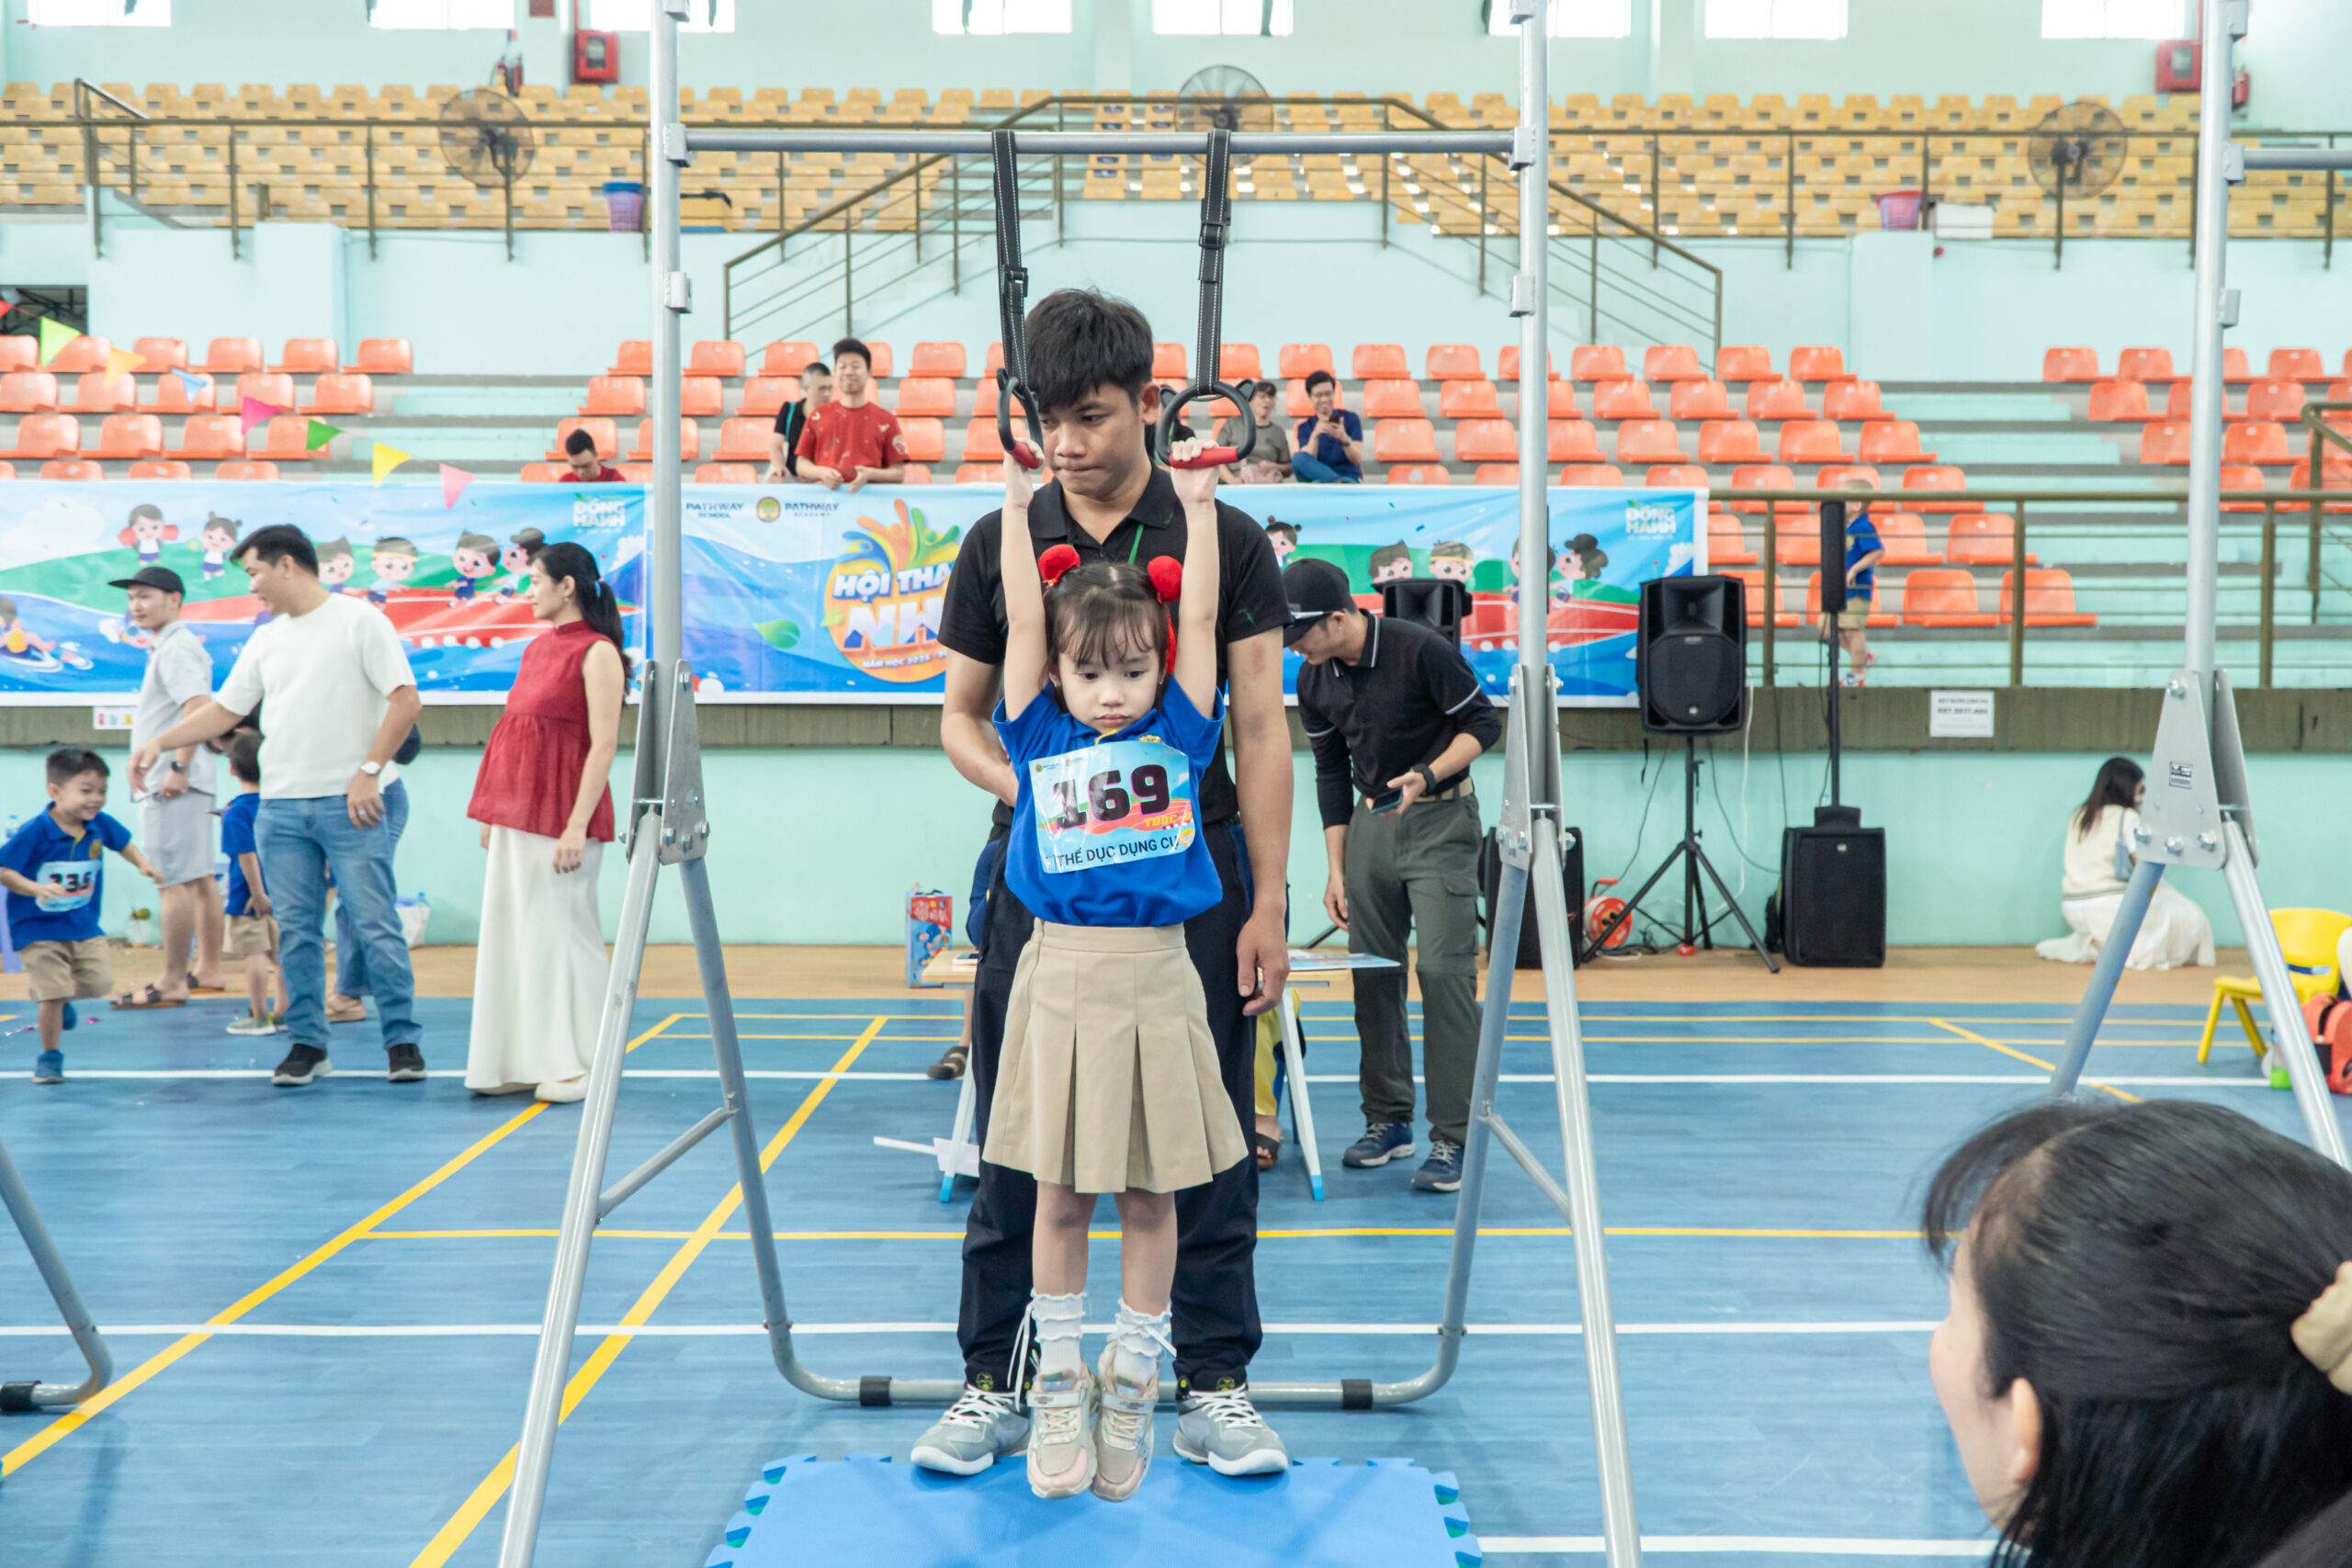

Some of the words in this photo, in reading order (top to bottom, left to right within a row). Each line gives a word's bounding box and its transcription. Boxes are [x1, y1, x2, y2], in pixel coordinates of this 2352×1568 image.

[686, 502, 744, 511] PATHWAY
[785, 502, 840, 511] PATHWAY
[831, 568, 891, 604] HỘI
[896, 560, 953, 595] THA
[843, 595, 943, 649] NH
[1053, 764, 1171, 831] 169
[1057, 846, 1083, 867] THỂ
[1086, 845, 1115, 863] DỤC
[1119, 839, 1158, 857] DỤNG
[1160, 835, 1180, 851] CỤ
